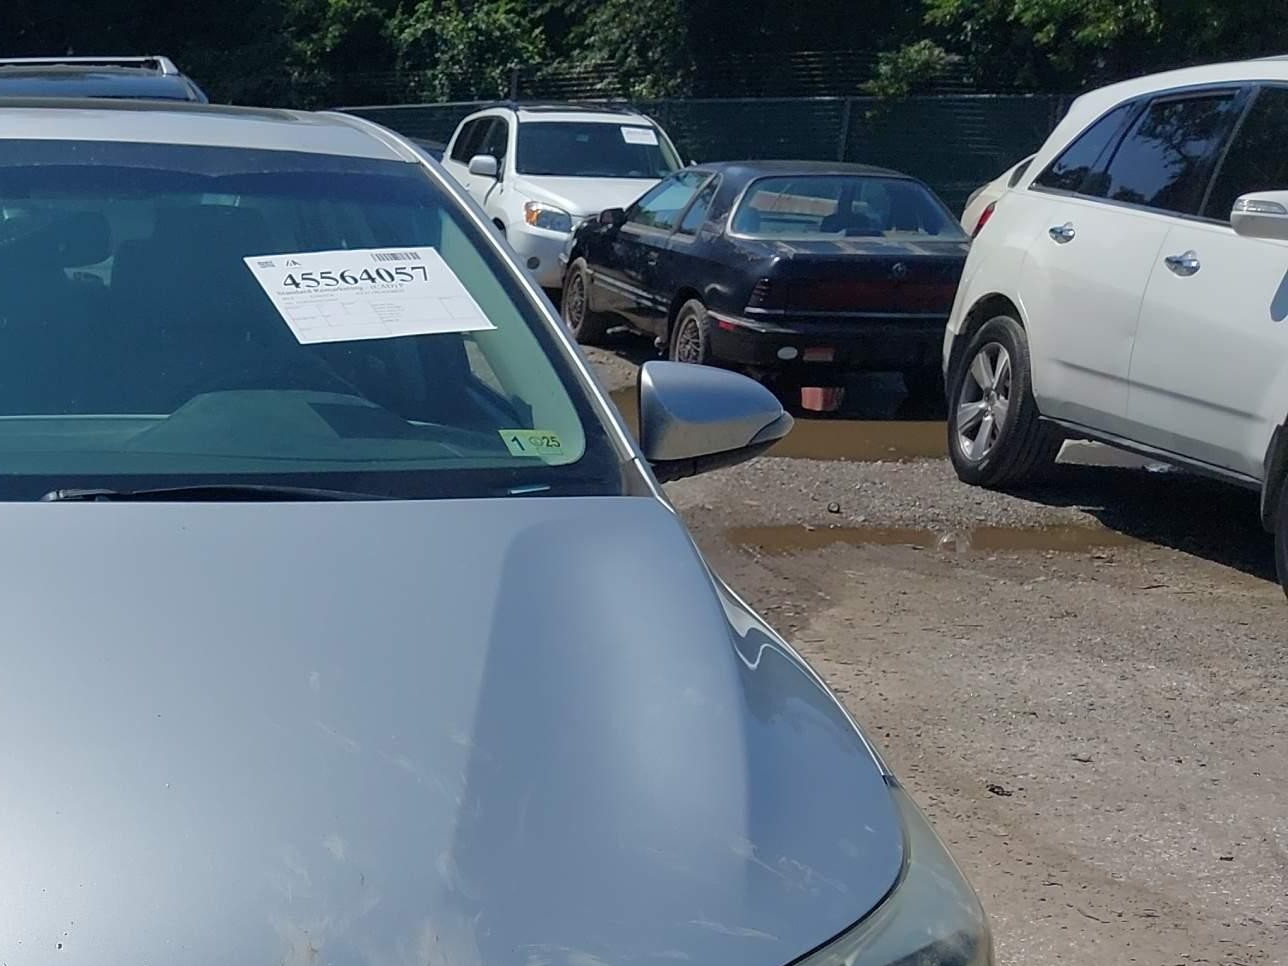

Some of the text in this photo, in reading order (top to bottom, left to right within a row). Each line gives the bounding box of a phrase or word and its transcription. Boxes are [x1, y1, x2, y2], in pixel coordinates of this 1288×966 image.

[283, 266, 429, 289] 45564057
[511, 436, 561, 451] 1 25
